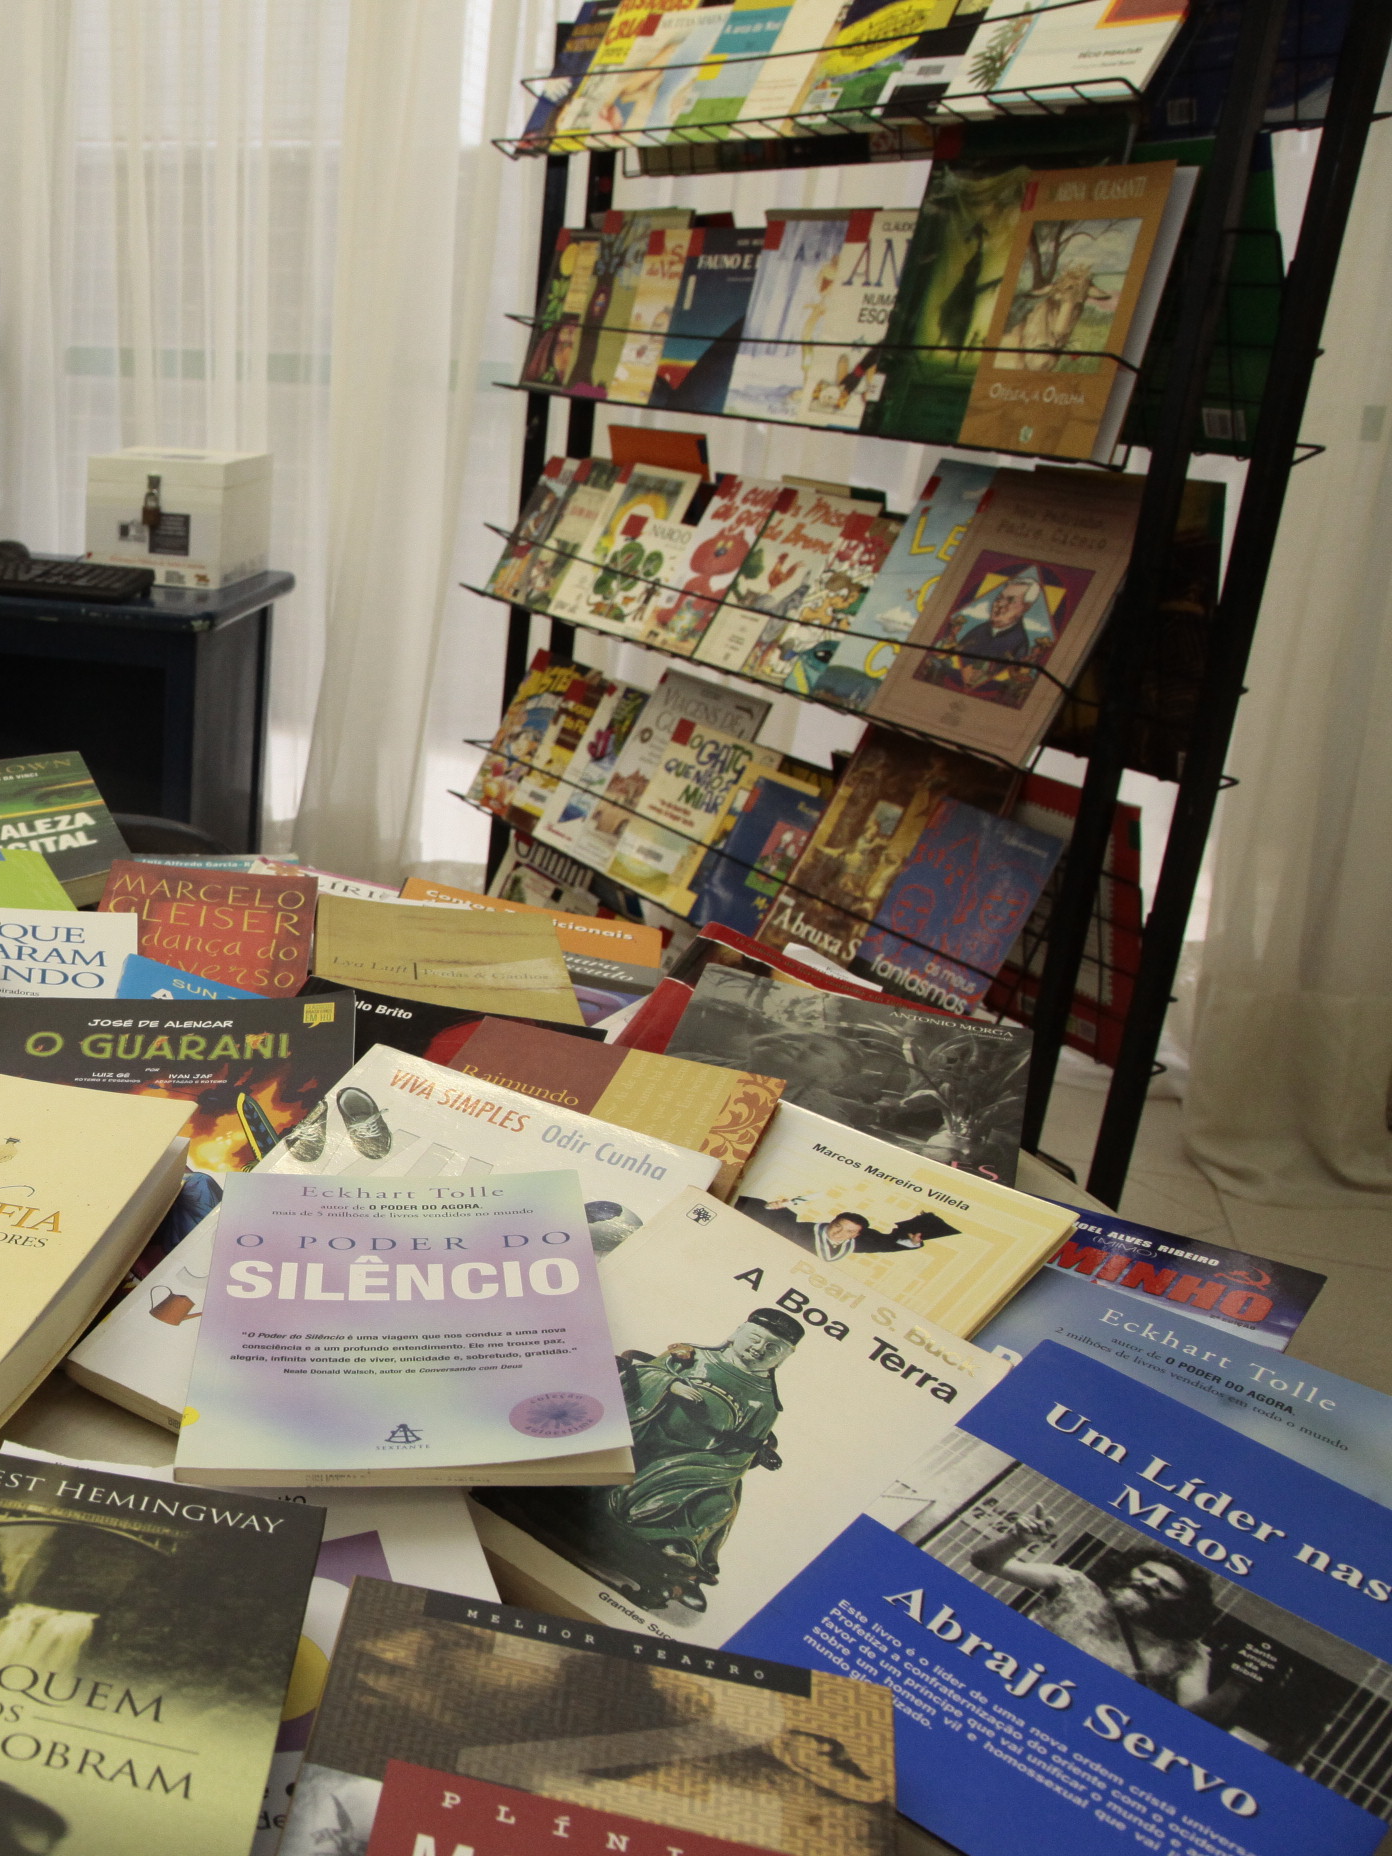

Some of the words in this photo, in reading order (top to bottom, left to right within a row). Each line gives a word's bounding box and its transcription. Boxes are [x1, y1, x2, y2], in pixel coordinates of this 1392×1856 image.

[108, 895, 302, 937] GLEISER
[112, 873, 305, 910] MARCELO
[141, 926, 242, 957] dança
[257, 938, 298, 962] do
[870, 953, 967, 1015] fantasmas
[88, 1018, 135, 1028] JOSÉ
[138, 1019, 160, 1028] DE
[164, 1020, 233, 1028] ALENCAR
[375, 1005, 413, 1021] Brito
[889, 1011, 957, 1029] ANTONIO
[80, 1031, 292, 1061] GUARANI
[461, 1063, 579, 1108] Raimundo
[388, 1069, 437, 1100] VIVA
[438, 1087, 531, 1133] SIMPLES
[540, 1123, 592, 1152] Odir
[594, 1143, 667, 1181] Cunha
[301, 1186, 414, 1199] Eckhart
[429, 1186, 504, 1199] Tolle
[812, 1142, 860, 1169] Marcos
[864, 1165, 923, 1194] Marreiro
[927, 1187, 970, 1211] Villela
[235, 1233, 266, 1248] O
[298, 1235, 470, 1251] PODER
[501, 1230, 573, 1249] DO
[1092, 1234, 1159, 1259] (MIMO)
[1107, 1230, 1153, 1249] ALVES
[1157, 1244, 1220, 1267] RIBEIRO
[226, 1255, 579, 1301] SILÊNCIO
[733, 1267, 765, 1291] A
[775, 1287, 851, 1342] Boa
[867, 1336, 958, 1404] Terra
[789, 1260, 866, 1309] Pearl
[870, 1306, 898, 1332] S.
[901, 1323, 982, 1378] Buck
[1098, 1308, 1233, 1369] Eckhart
[1249, 1361, 1338, 1412] Tolle
[1111, 1337, 1142, 1355] autor
[1144, 1350, 1162, 1362] de
[1165, 1355, 1175, 1365] O
[1178, 1359, 1222, 1383] PODER
[1224, 1378, 1247, 1392] DO
[1248, 1387, 1296, 1416] AGORA.
[1044, 1400, 1130, 1464] Um
[54, 1479, 285, 1535] HEMINGWAY
[1106, 1483, 1254, 1576] Mãos
[1144, 1470, 1287, 1546] Líder
[1291, 1539, 1392, 1604] nas
[466, 1606, 598, 1647] MELHOR
[632, 1642, 767, 1682] TEATRO
[881, 1587, 1079, 1712] Abrajó
[1082, 1702, 1262, 1820] Servo
